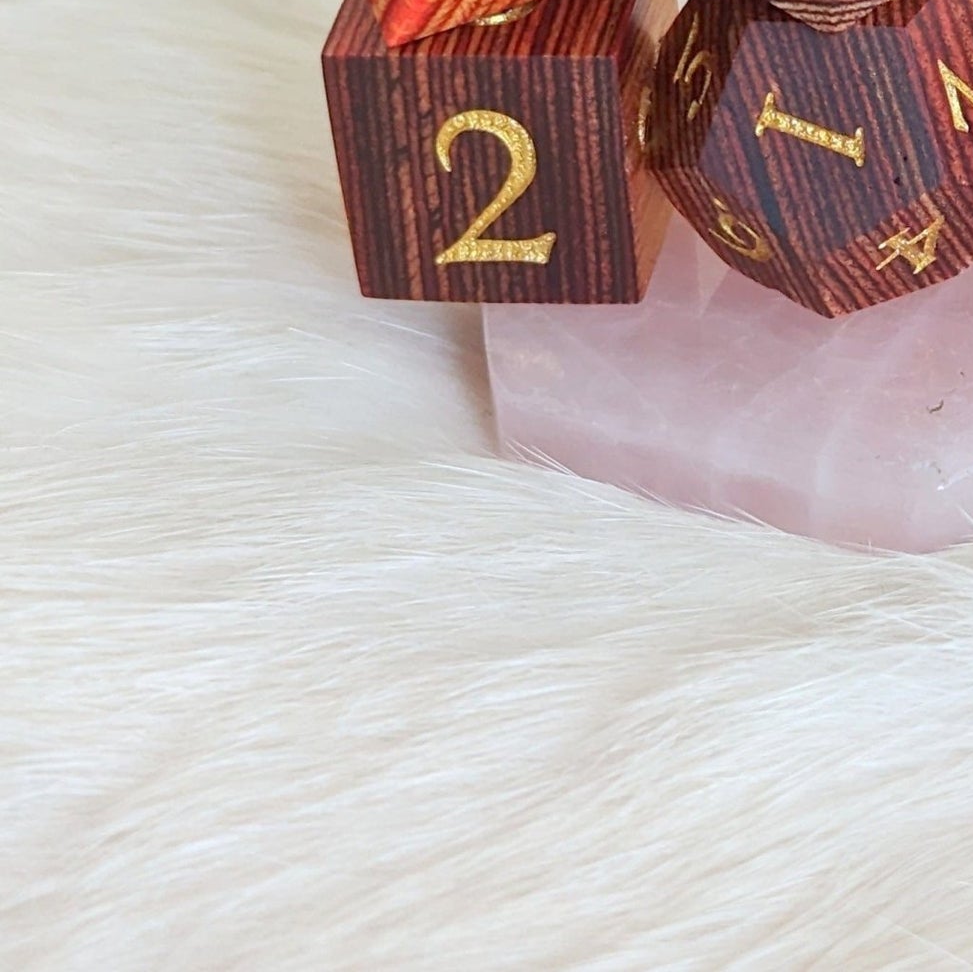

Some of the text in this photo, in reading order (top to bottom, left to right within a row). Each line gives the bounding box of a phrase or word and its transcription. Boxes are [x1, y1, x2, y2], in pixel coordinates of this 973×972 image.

[755, 91, 867, 168] 1
[434, 109, 557, 265] 2
[876, 214, 945, 275] 4
